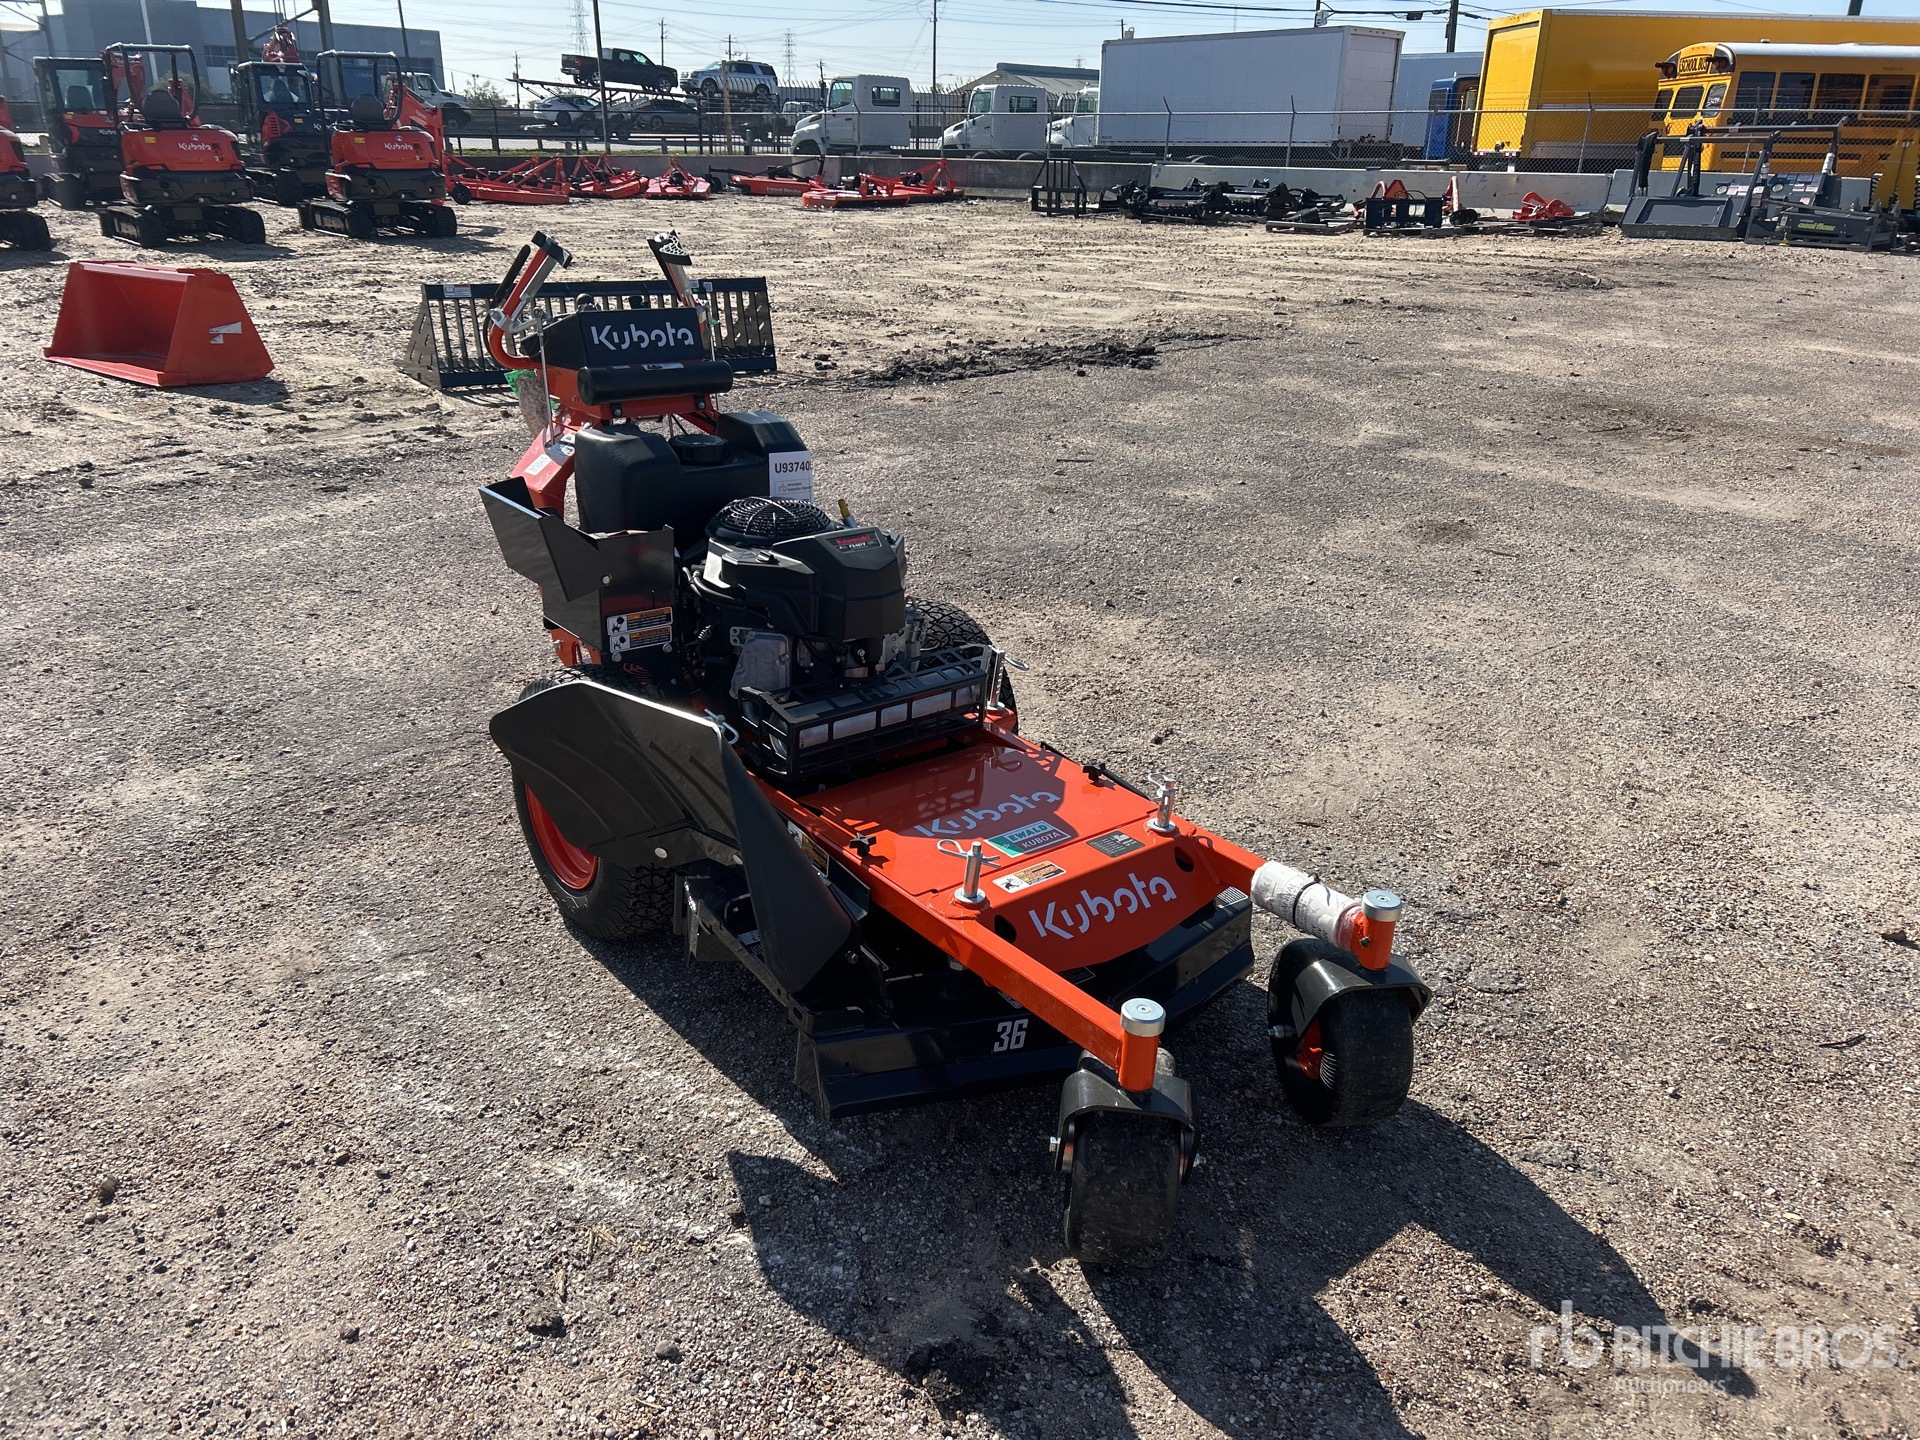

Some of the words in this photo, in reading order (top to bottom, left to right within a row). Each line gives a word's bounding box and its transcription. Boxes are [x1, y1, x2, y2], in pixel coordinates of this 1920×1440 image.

[177, 142, 212, 151] Kubota
[383, 142, 413, 151] Kubota
[590, 321, 695, 351] Kubota
[914, 791, 1062, 838] Kubota
[1008, 823, 1050, 843] EWALD
[1021, 831, 1062, 850] KUBOTA
[1028, 872, 1177, 940] Kubota
[993, 1018, 1029, 1052] 36
